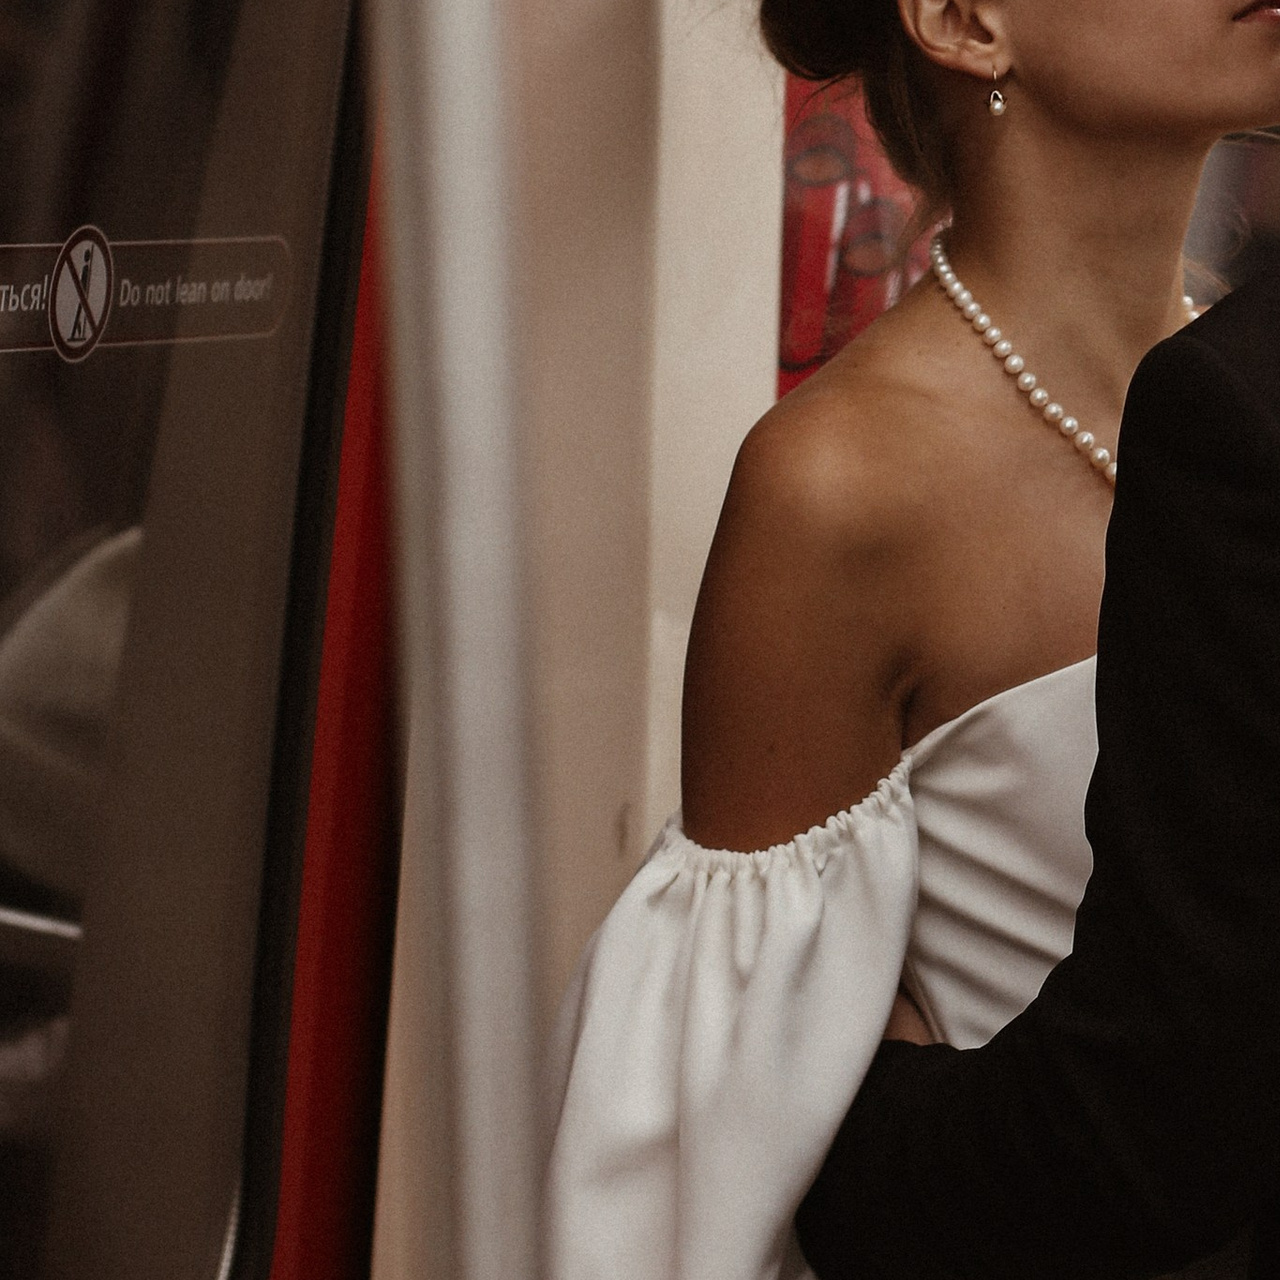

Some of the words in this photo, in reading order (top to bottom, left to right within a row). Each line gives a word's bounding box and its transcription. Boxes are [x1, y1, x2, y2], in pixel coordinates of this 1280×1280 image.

[119, 278, 141, 307] Do
[146, 279, 171, 306] not
[176, 275, 207, 306] lean
[211, 280, 230, 303] on
